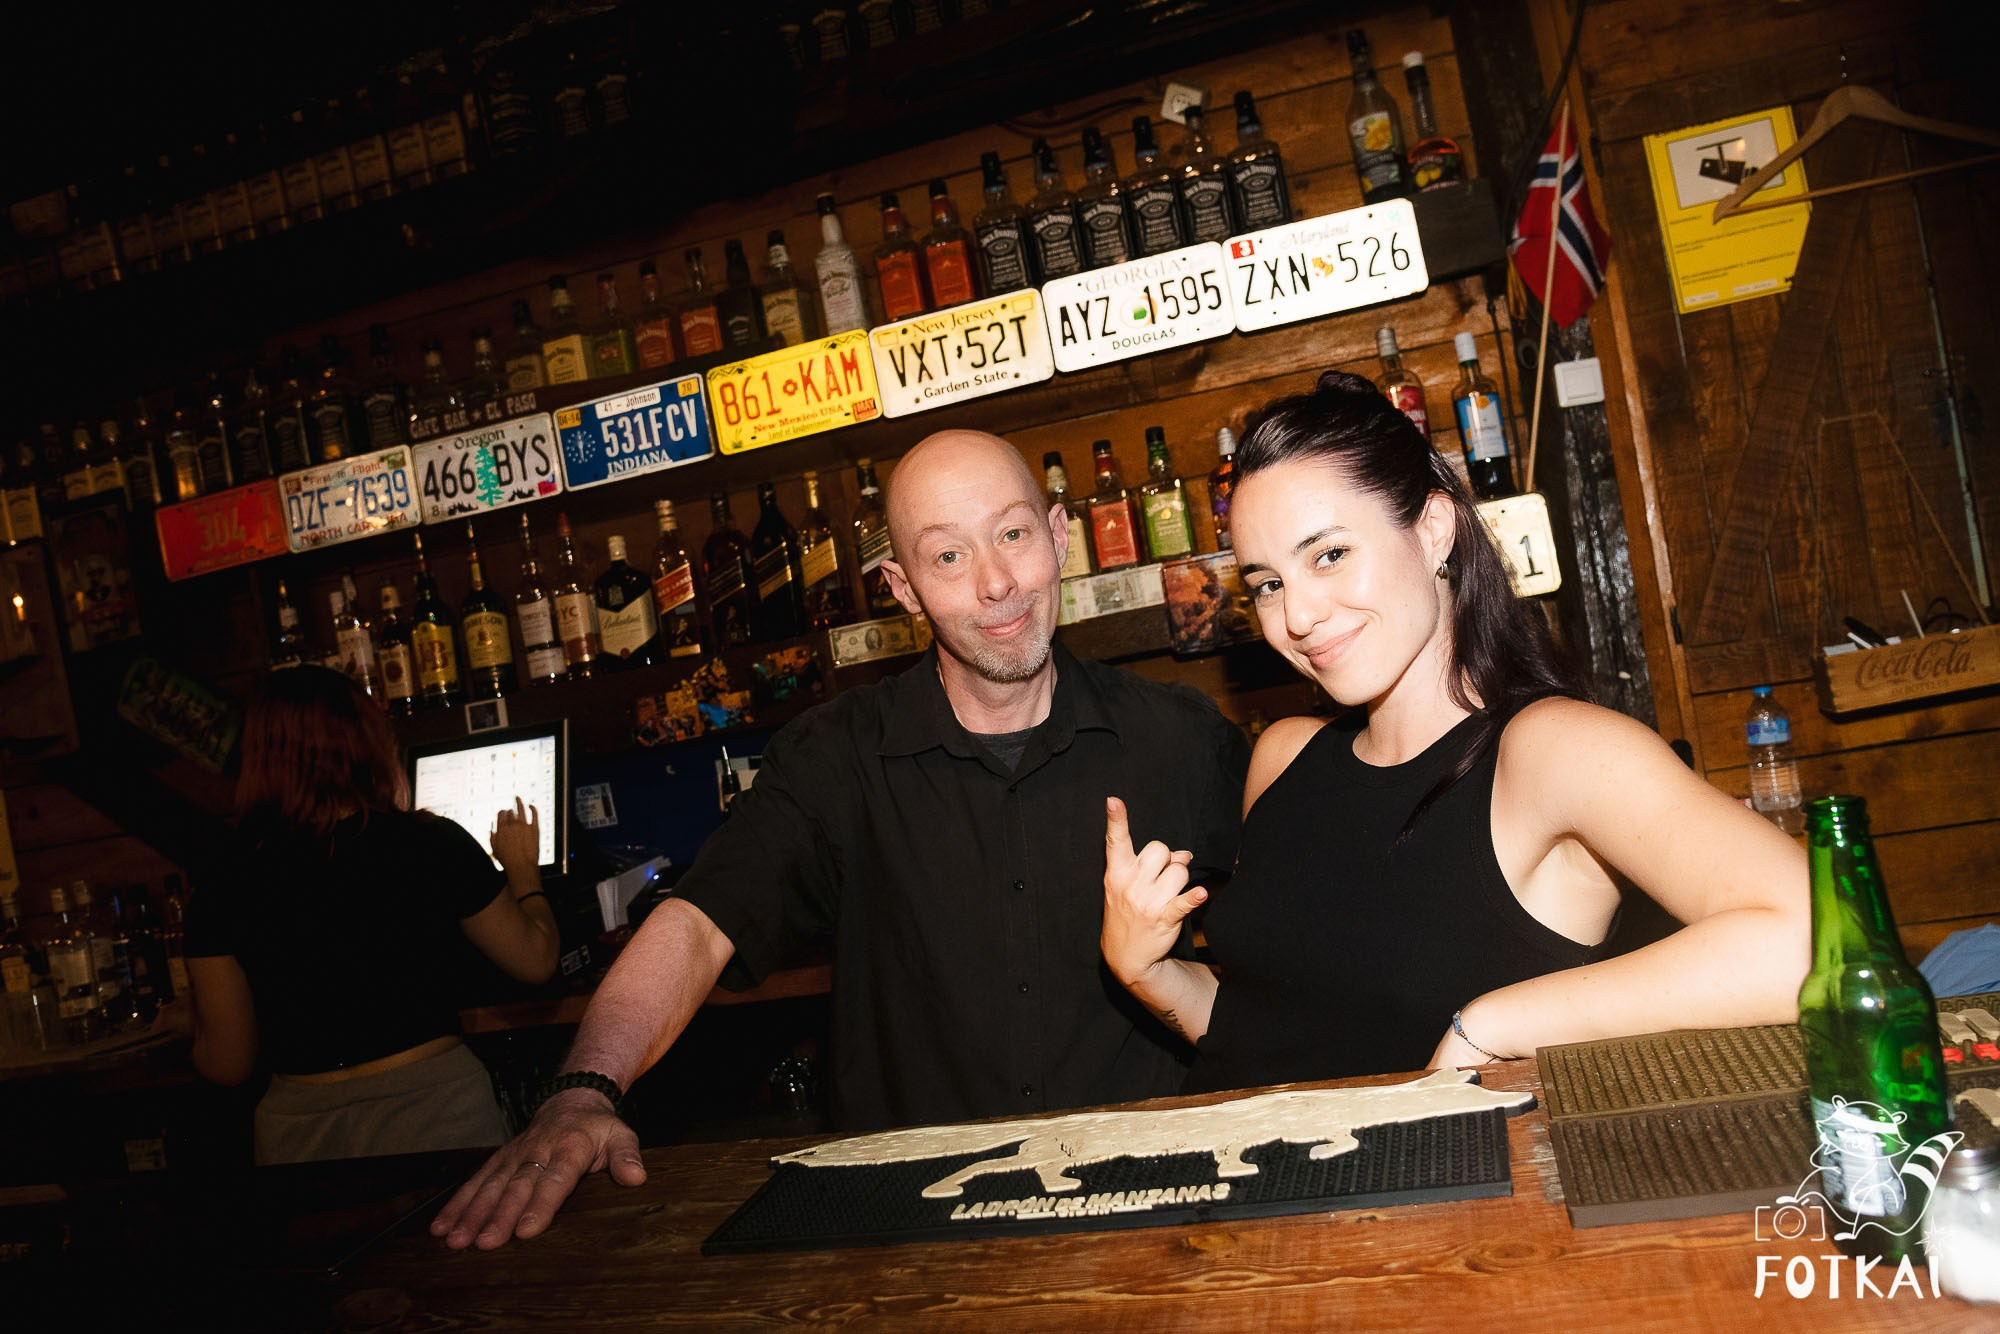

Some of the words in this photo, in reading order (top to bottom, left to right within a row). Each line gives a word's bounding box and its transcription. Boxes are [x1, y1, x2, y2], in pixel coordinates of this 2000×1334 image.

[1240, 241, 1251, 257] 3
[1282, 221, 1350, 249] Maryland
[1085, 258, 1181, 293] GEORGIA
[1239, 253, 1312, 306] ZXN
[1337, 231, 1411, 283] 526
[913, 316, 947, 337] New
[951, 307, 997, 331] Jersey
[1059, 296, 1117, 347] AYZ
[1143, 269, 1223, 325] 1595
[889, 336, 949, 388] VXT
[964, 315, 1028, 369] 52T
[1112, 327, 1177, 350] DOUGLAS
[626, 392, 657, 408] Johnson
[720, 372, 780, 425] 861
[799, 348, 863, 401] KAM
[924, 380, 969, 398] Garden
[974, 369, 1008, 385] State
[445, 409, 469, 430] BAR
[485, 401, 504, 417] EL
[507, 393, 537, 415] PASO
[602, 399, 698, 457] 531FCV
[753, 421, 775, 434] New
[777, 411, 818, 428] Mexico
[820, 404, 844, 417] USA
[454, 427, 505, 450] Oregon
[423, 452, 476, 502] 466
[493, 434, 550, 487] BYS
[607, 450, 670, 474] INDIANA
[287, 470, 411, 532] DZF-7639
[198, 508, 247, 551] 304
[301, 525, 342, 545] NORTH
[347, 513, 408, 535] CARNA
[1519, 535, 1543, 578] 1
[1085, 1183, 1231, 1211] MANZANAS
